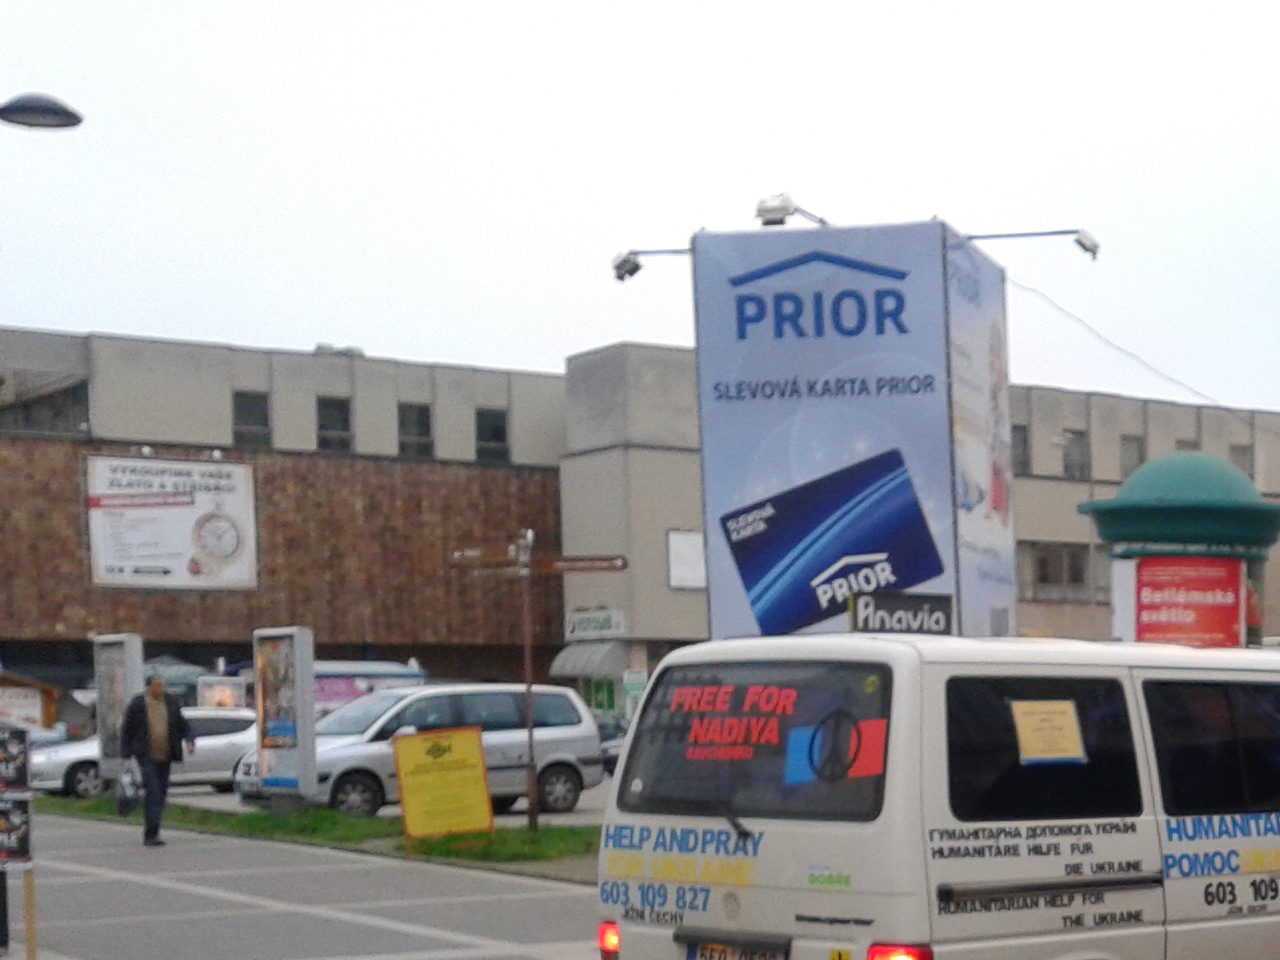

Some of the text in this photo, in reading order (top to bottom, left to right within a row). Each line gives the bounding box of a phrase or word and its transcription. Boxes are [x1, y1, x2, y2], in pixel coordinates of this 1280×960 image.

[736, 289, 909, 340] PRIOR
[713, 374, 935, 400] SLEVOVÁ KARTA PRIOR
[816, 562, 897, 609] PRIOR
[670, 685, 798, 715] FREE FOR
[688, 717, 779, 744] NADIYA
[604, 824, 765, 857] HELP AND PRAY
[1091, 860, 1143, 874] UKRAINE
[1164, 850, 1241, 878] POMOC
[600, 881, 711, 912] 603 109 827
[1043, 895, 1075, 908] HELP
[1082, 892, 1105, 905] FOR
[1204, 881, 1237, 906] 603
[1250, 878, 1279, 901] 109
[1062, 910, 1144, 928] THE UKRAINE
